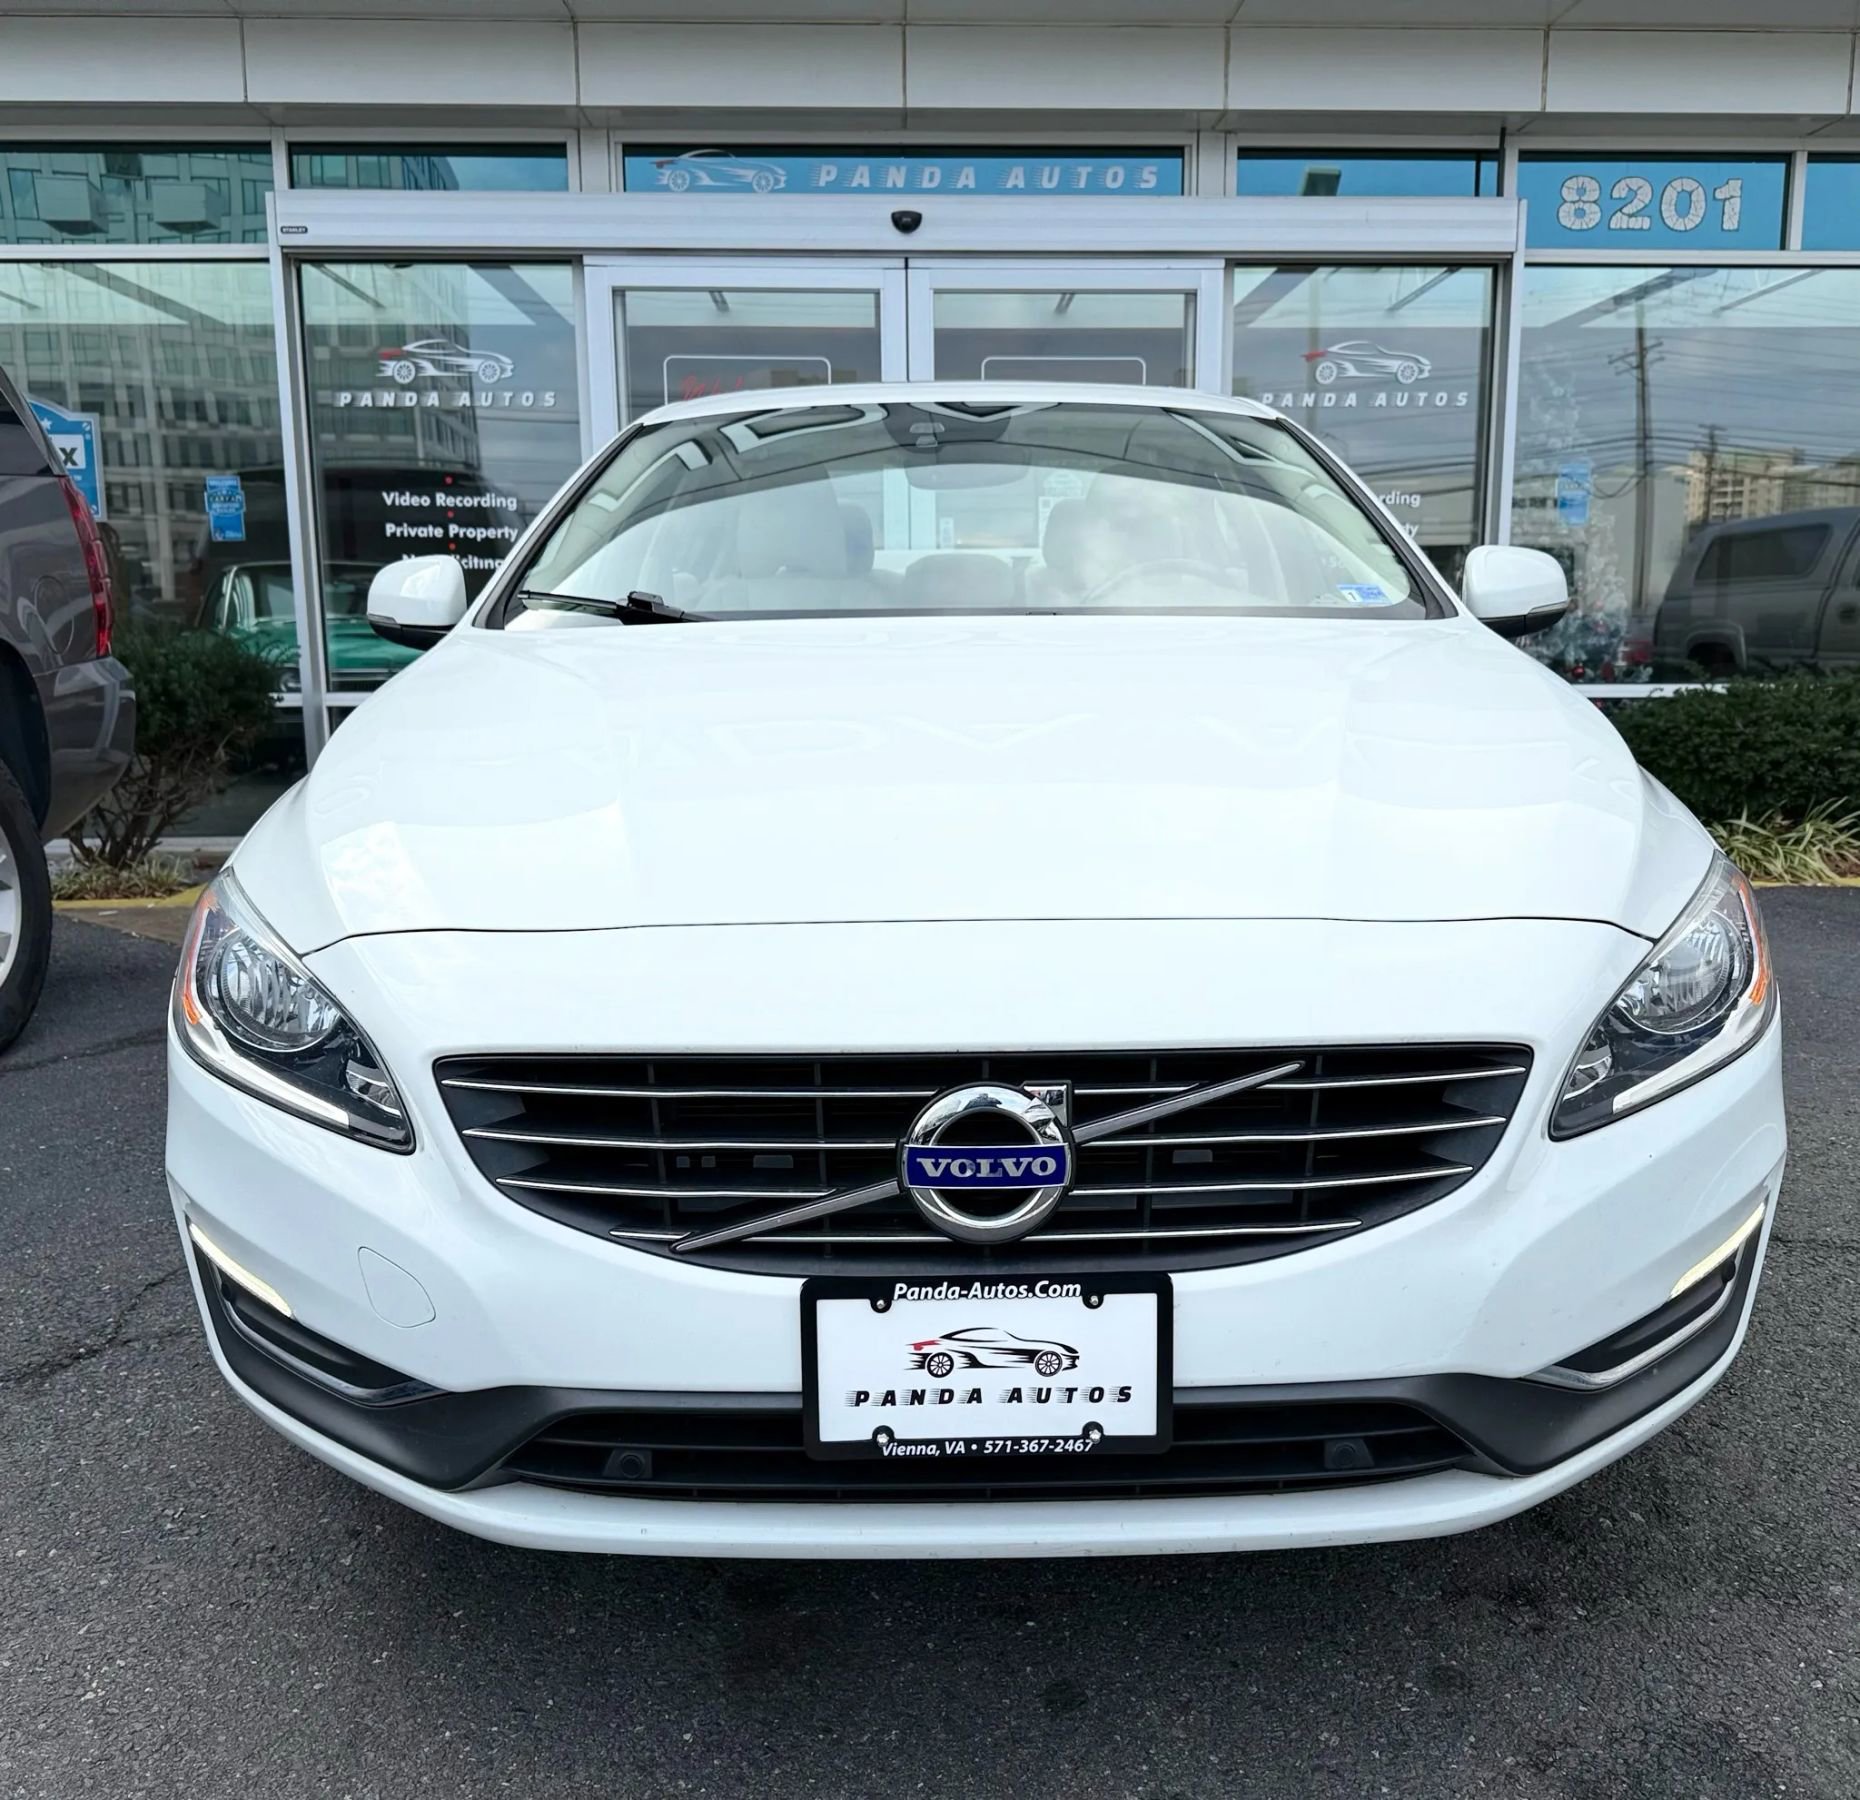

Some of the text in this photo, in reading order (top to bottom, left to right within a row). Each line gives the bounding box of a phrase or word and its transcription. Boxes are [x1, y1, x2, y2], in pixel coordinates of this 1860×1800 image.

[813, 164, 1159, 190] PANDA AUTOS
[1556, 175, 1743, 232] 8201
[336, 391, 557, 407] PANDA AUTOS
[1259, 391, 1469, 408] PANDA AUTOS
[381, 491, 518, 511] Video Recording
[1379, 491, 1421, 508] rding
[384, 523, 519, 542] Private Property
[916, 1156, 1057, 1178] VOLVO
[893, 1280, 1082, 1301] Panda-Autos.Com
[847, 1385, 1133, 1408] PANDA AUTOS
[881, 1438, 1094, 1457] Vienna, VA 571-367-2467
